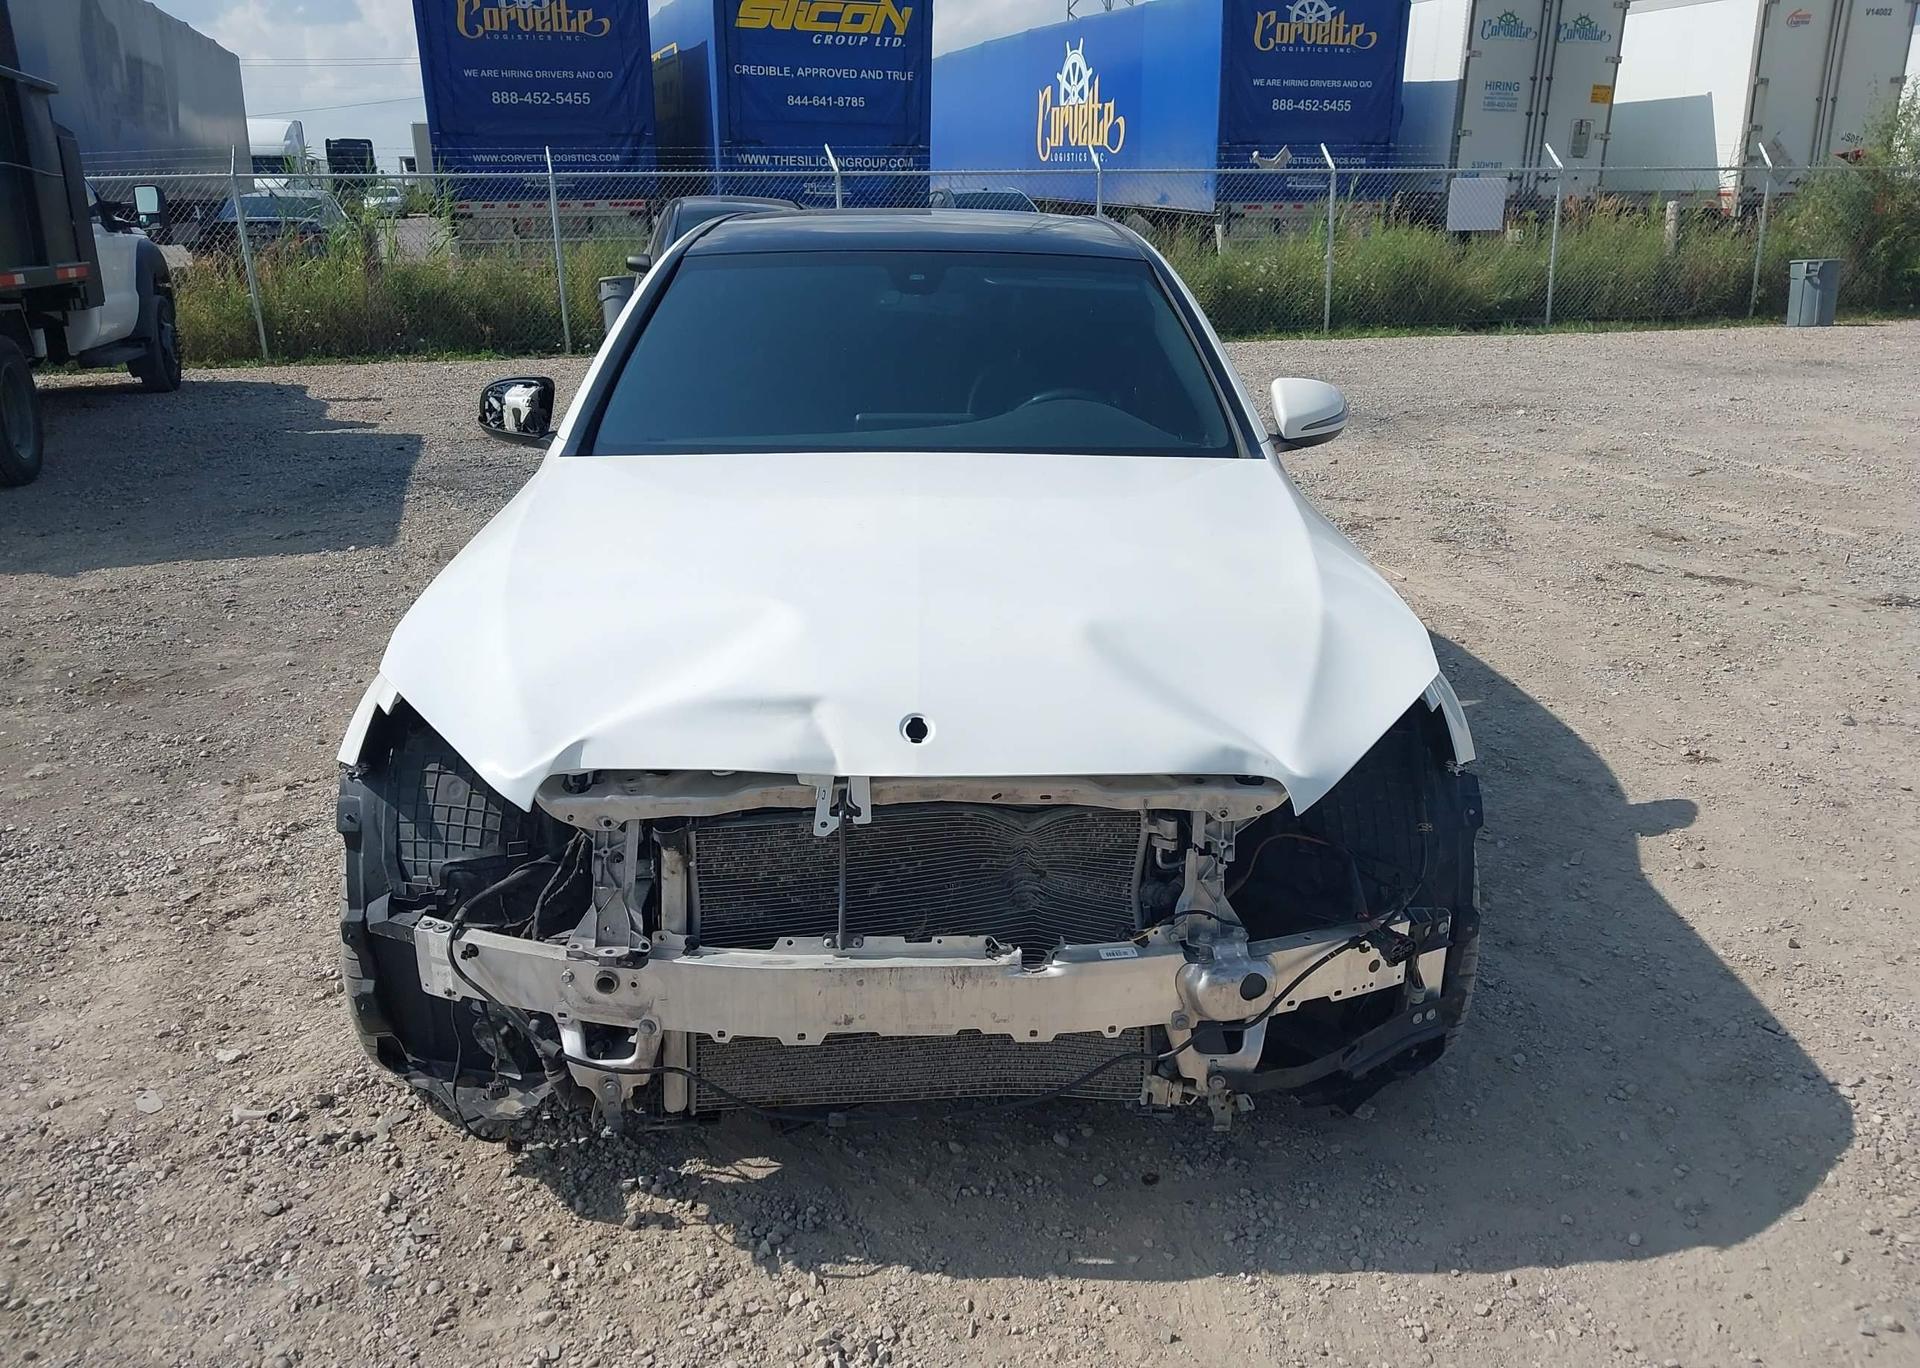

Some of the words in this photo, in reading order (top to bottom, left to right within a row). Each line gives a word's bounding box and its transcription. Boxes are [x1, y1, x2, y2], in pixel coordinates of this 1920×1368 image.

[457, 0, 611, 39] Corvette
[1253, 10, 1378, 51] Corvette
[1481, 19, 1538, 40] Corvette
[485, 33, 552, 41] LOGISTICS
[812, 33, 868, 46] GROUP
[875, 36, 906, 48] LTD.
[463, 69, 479, 78] WE
[480, 69, 499, 78] ARE
[500, 70, 534, 79] HIRING
[535, 71, 574, 79] DRIVERS
[576, 71, 595, 79] AND
[734, 64, 794, 78] CREDIBLE,
[797, 67, 857, 79] APPROVED
[860, 69, 883, 80] AND
[887, 70, 914, 81] TRUE
[1253, 79, 1265, 87] WE
[1266, 79, 1281, 87] ARE
[1283, 79, 1309, 88] HIRING
[1310, 80, 1341, 88] DRIVERS
[1342, 80, 1358, 88] AND
[1485, 80, 1520, 92] HIRING
[491, 91, 591, 105] 888-452-5455
[787, 95, 865, 107] 844-641-8785
[1271, 99, 1352, 111] 888-452-5455
[1037, 73, 1125, 162] Corvette
[1050, 152, 1088, 162] LOGISTICS
[1091, 152, 1108, 162] C.
